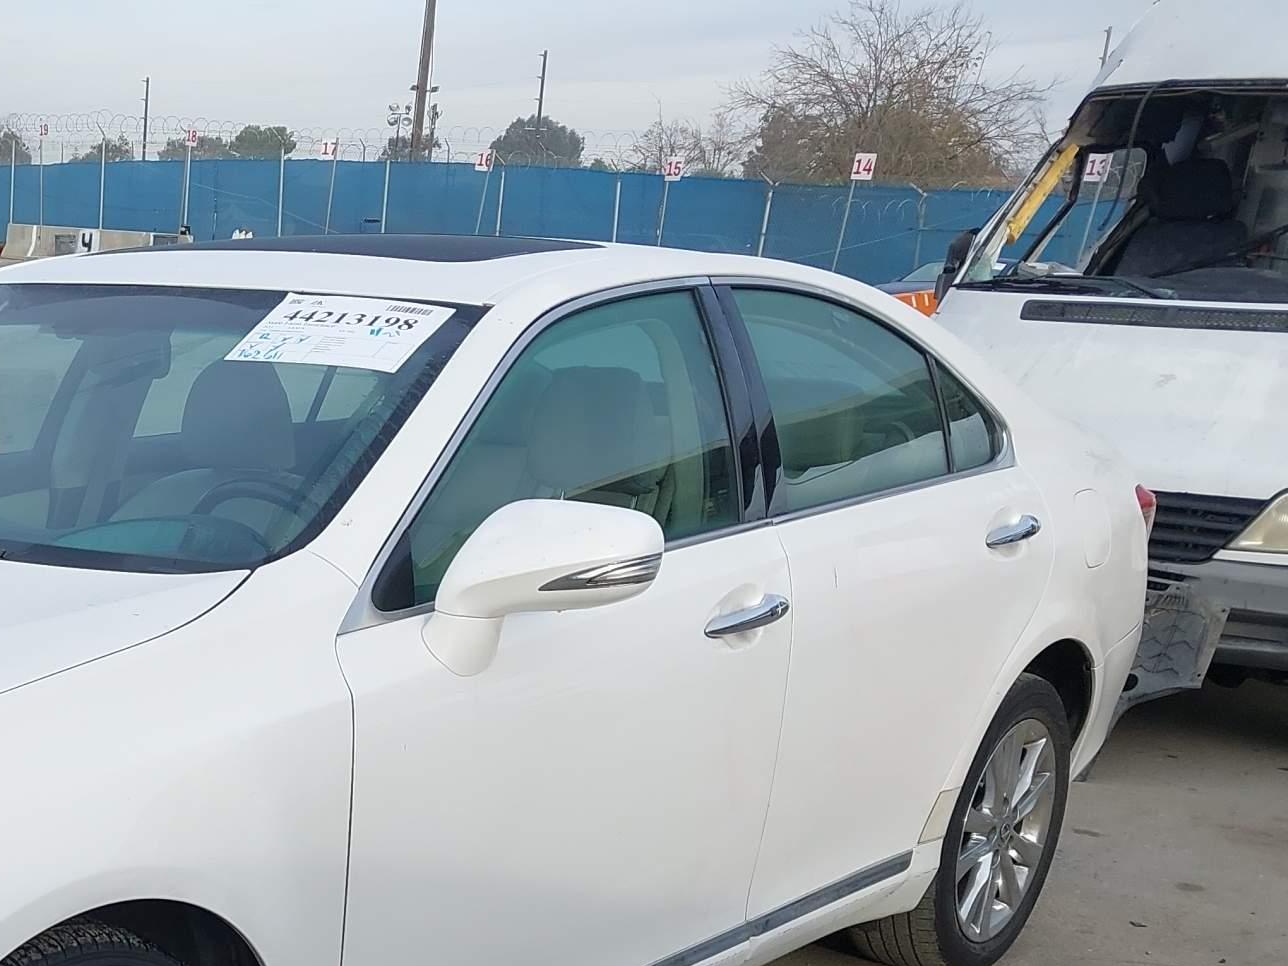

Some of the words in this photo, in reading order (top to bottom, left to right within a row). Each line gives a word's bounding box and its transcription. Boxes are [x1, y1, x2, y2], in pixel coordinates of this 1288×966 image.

[39, 123, 49, 136] 19
[186, 129, 198, 143] 18
[321, 141, 339, 156] 17
[666, 160, 683, 177] 15
[852, 158, 873, 175] 14
[1085, 158, 1110, 176] 13
[81, 232, 93, 253] 4
[283, 309, 419, 331] 44213198
